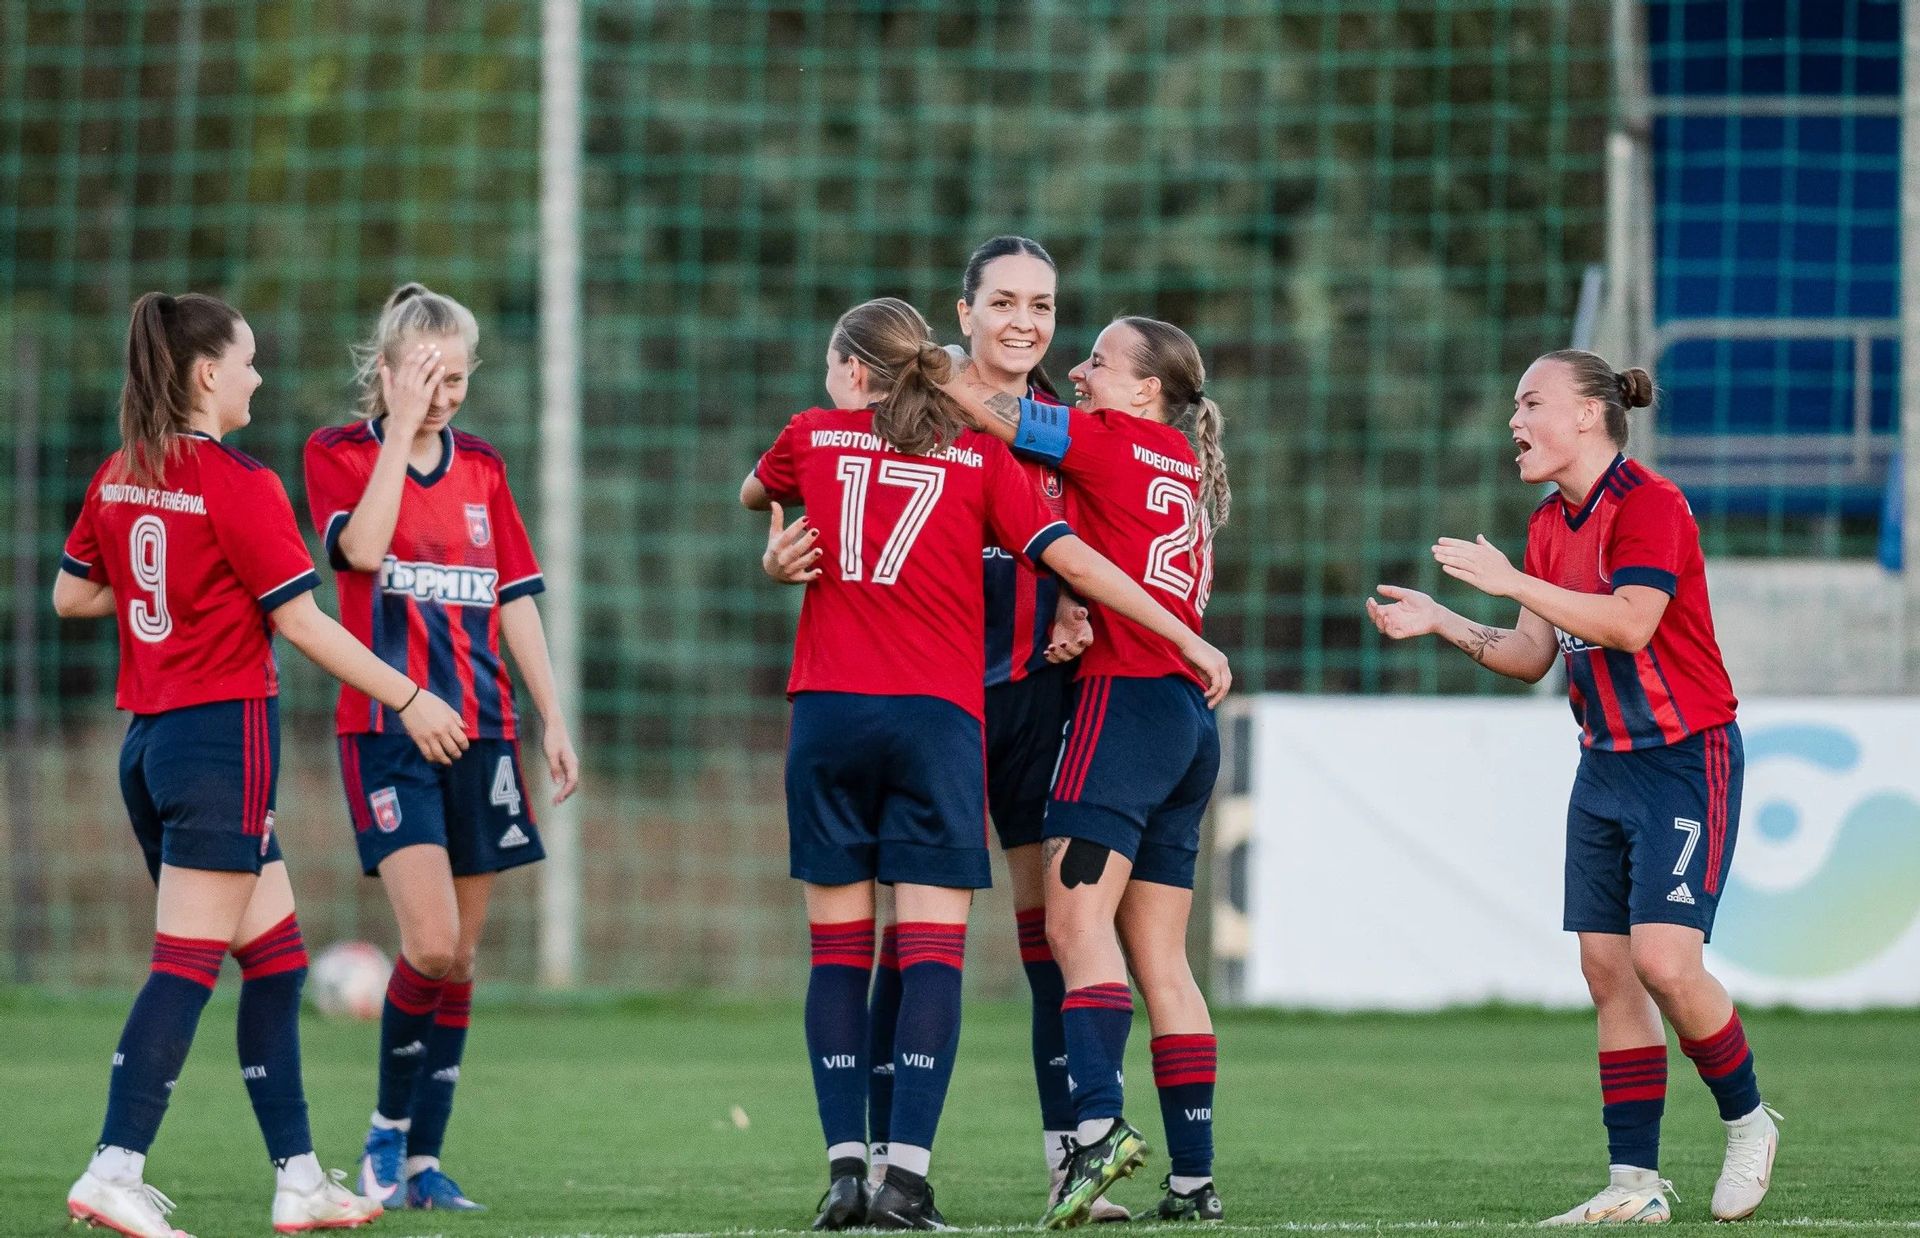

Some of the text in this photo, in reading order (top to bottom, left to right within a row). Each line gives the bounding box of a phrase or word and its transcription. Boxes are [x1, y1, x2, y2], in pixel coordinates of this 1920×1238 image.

[811, 430, 882, 452] VIDEOTON
[1132, 443, 1194, 479] VIDEOTON
[146, 488, 160, 507] FC
[837, 455, 946, 585] 17
[129, 514, 173, 643] 9
[490, 755, 521, 816] 4
[1672, 817, 1701, 876] 7
[1666, 894, 1695, 905] adidas
[822, 1054, 855, 1069] VIDI
[902, 1053, 935, 1069] VIDI
[1185, 1108, 1211, 1121] VIDI
